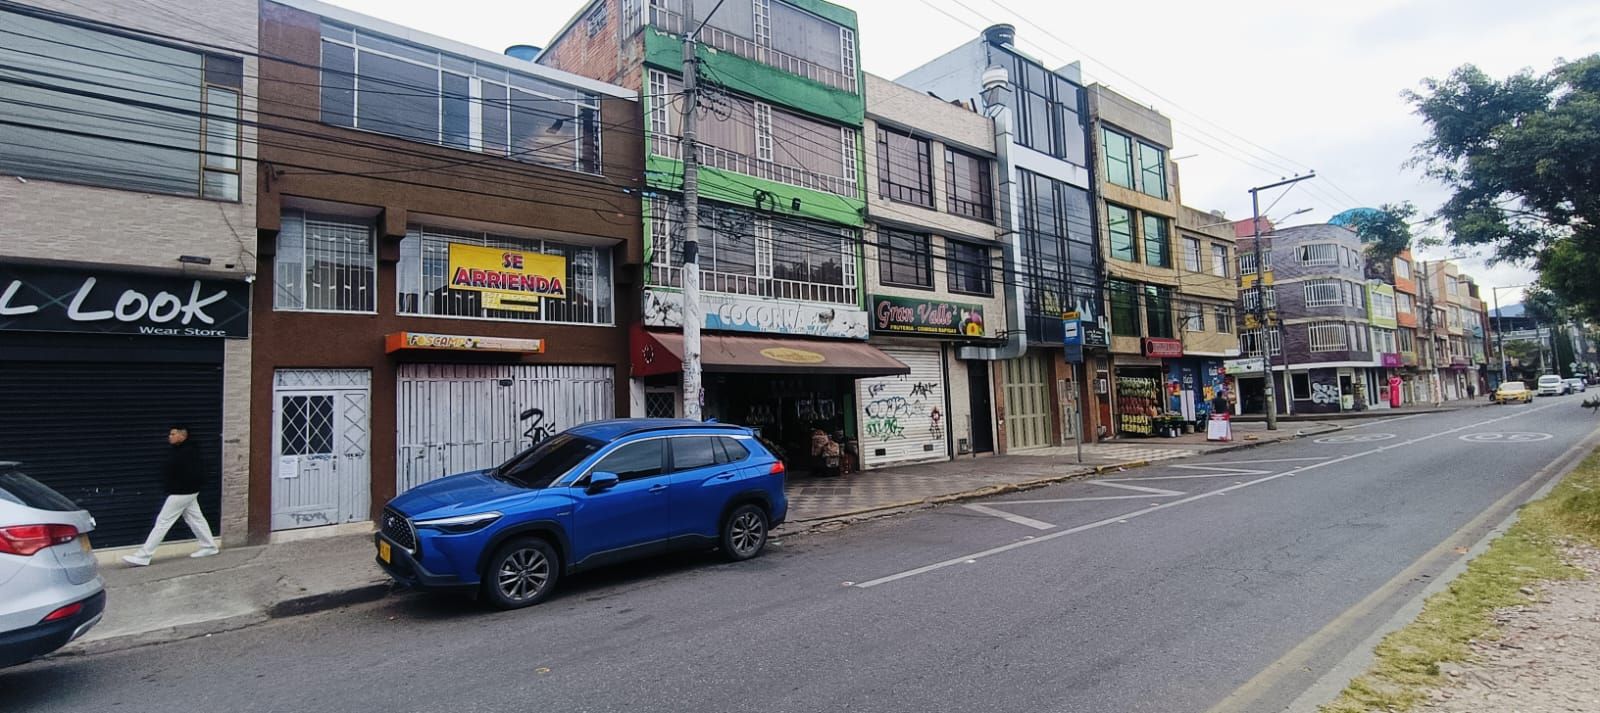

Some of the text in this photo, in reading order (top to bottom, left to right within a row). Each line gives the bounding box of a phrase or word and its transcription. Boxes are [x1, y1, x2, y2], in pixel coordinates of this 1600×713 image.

[502, 252, 524, 270] SE
[452, 266, 565, 296] ARRIENDA
[878, 301, 914, 328] Gran
[139, 326, 227, 337] Wear Store
